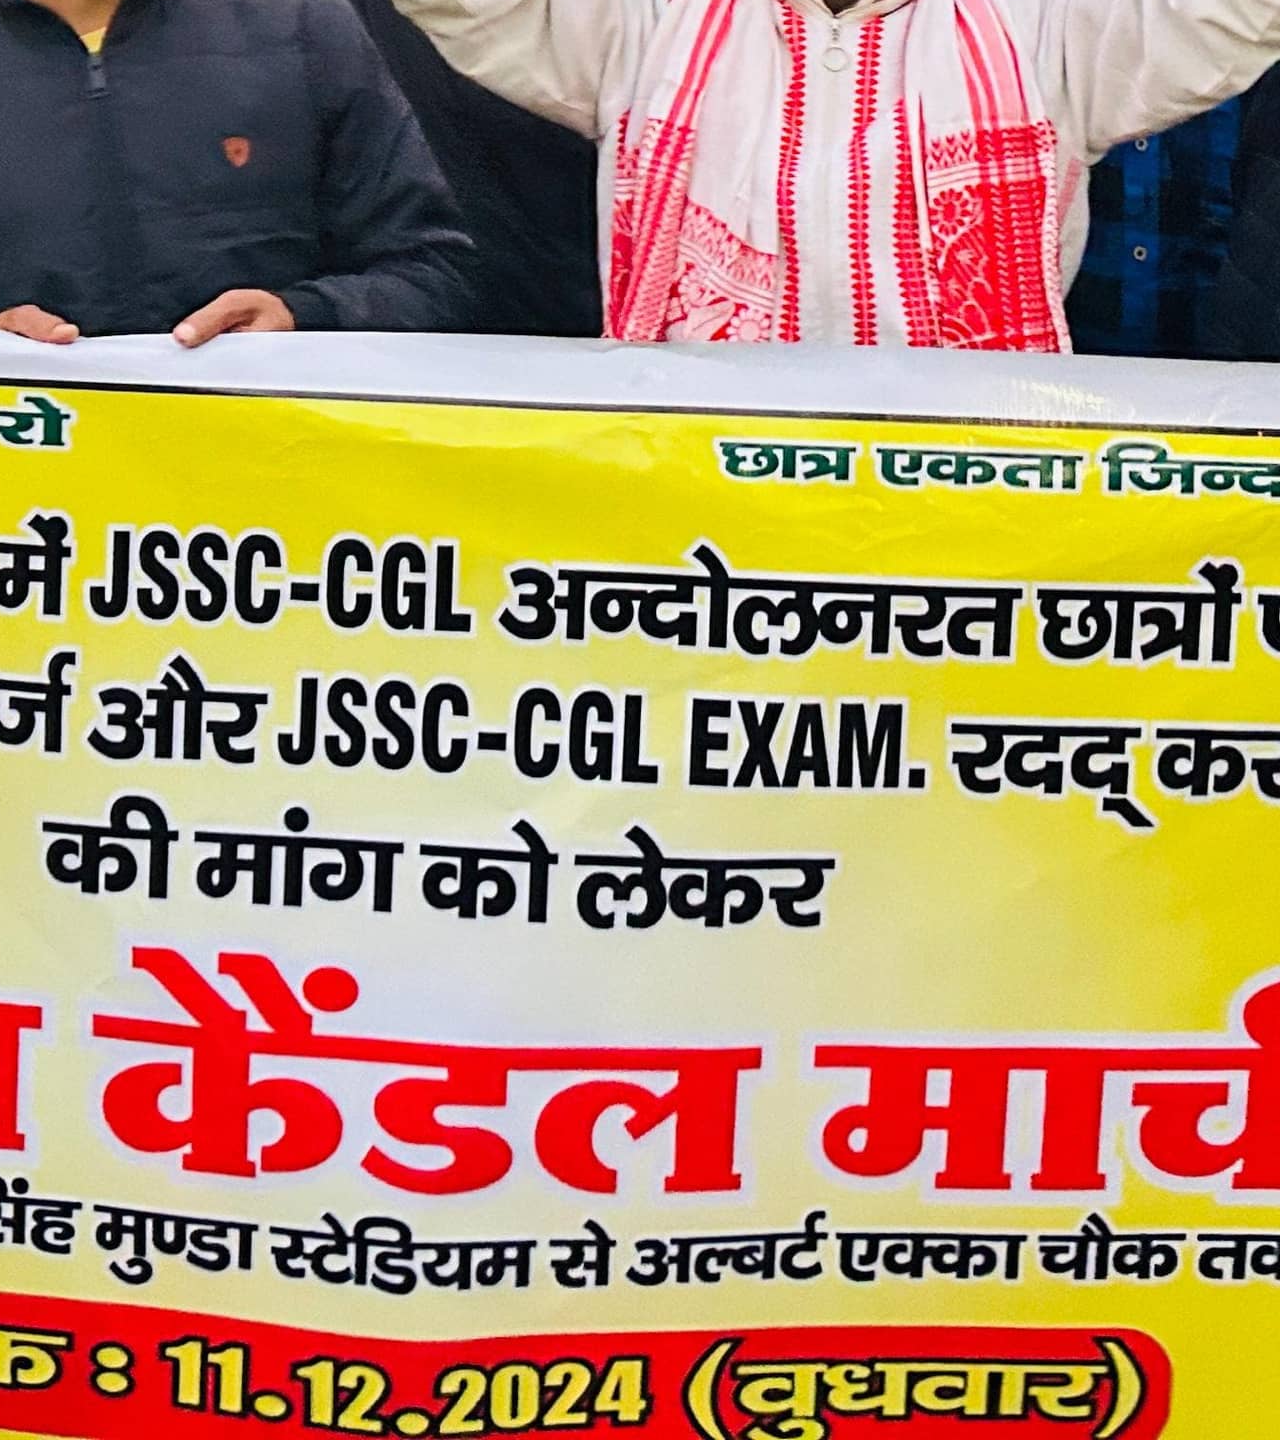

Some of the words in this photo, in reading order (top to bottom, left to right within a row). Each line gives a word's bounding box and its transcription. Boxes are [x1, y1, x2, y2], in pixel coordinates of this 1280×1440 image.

[720, 443, 856, 480] छात्र
[877, 448, 1083, 489] एकता
[90, 531, 471, 632] JSSC-CGL
[499, 545, 1022, 656] अन्दोलनरत
[1037, 562, 1241, 662] छात्रों
[88, 656, 268, 763] और
[278, 678, 658, 783] JSSC-CGL
[689, 699, 925, 788] EXAM.
[43, 796, 179, 898] की
[195, 807, 404, 912] मांग
[420, 820, 558, 923] को
[575, 826, 835, 929] लेकर
[94, 1205, 258, 1285] मुण्डा
[270, 1213, 537, 1295] स्टेडियम
[549, 1220, 616, 1288] से
[626, 1211, 828, 1286] अल्बर्ट
[836, 1233, 1027, 1282] एक्का
[1039, 1213, 1186, 1280] चौक
[166, 1342, 645, 1433] 11.12.2024
